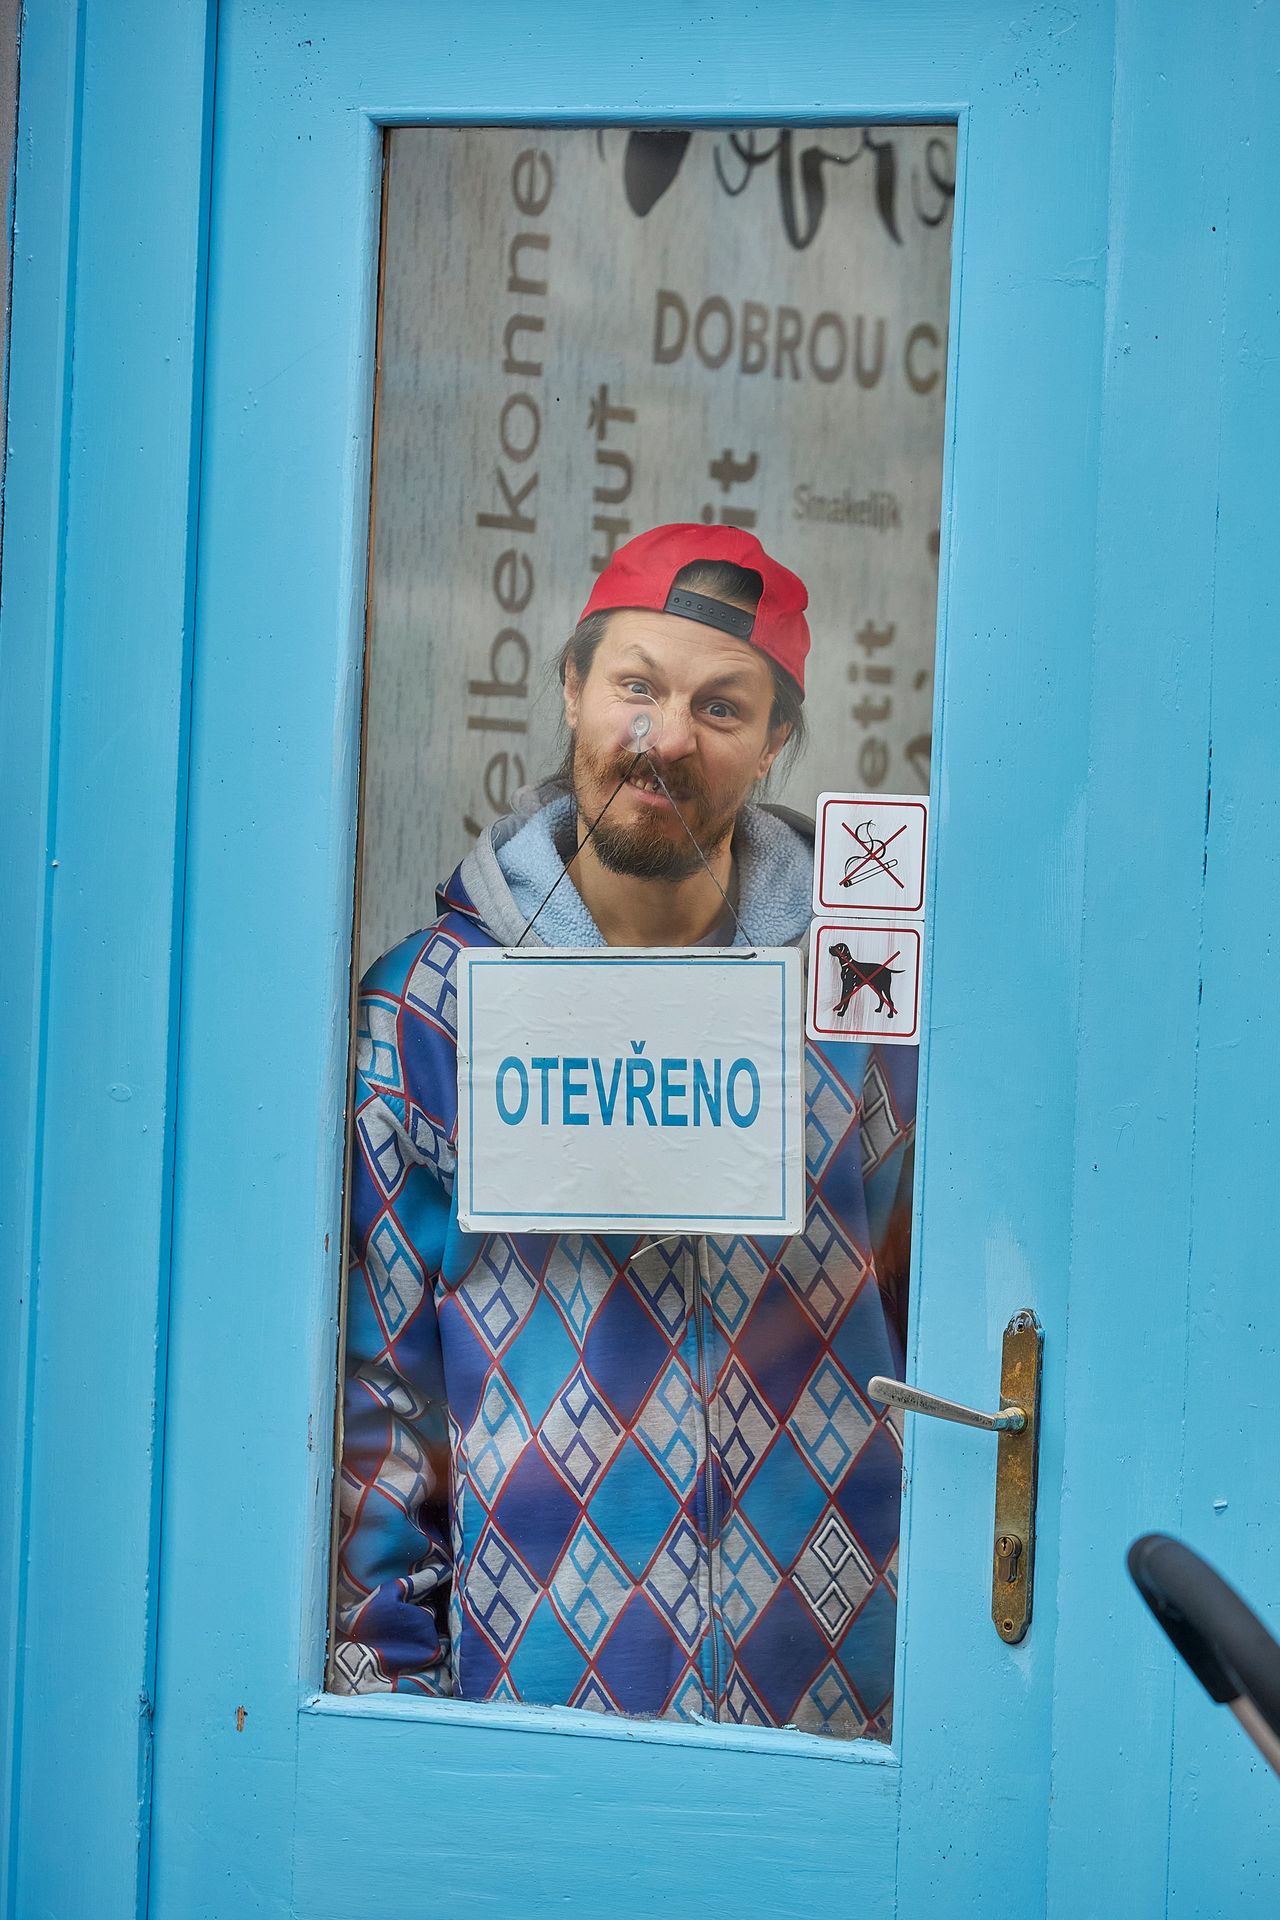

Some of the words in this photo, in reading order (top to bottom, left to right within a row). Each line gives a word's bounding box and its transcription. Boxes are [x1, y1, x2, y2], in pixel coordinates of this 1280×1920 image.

[653, 288, 888, 390] DOBROU
[904, 322, 942, 395] C
[463, 148, 554, 838] elbekonne
[586, 383, 637, 574] HUŤ
[702, 448, 759, 529] it
[848, 618, 897, 790] etit
[495, 1040, 761, 1129] OTEVŘENO
